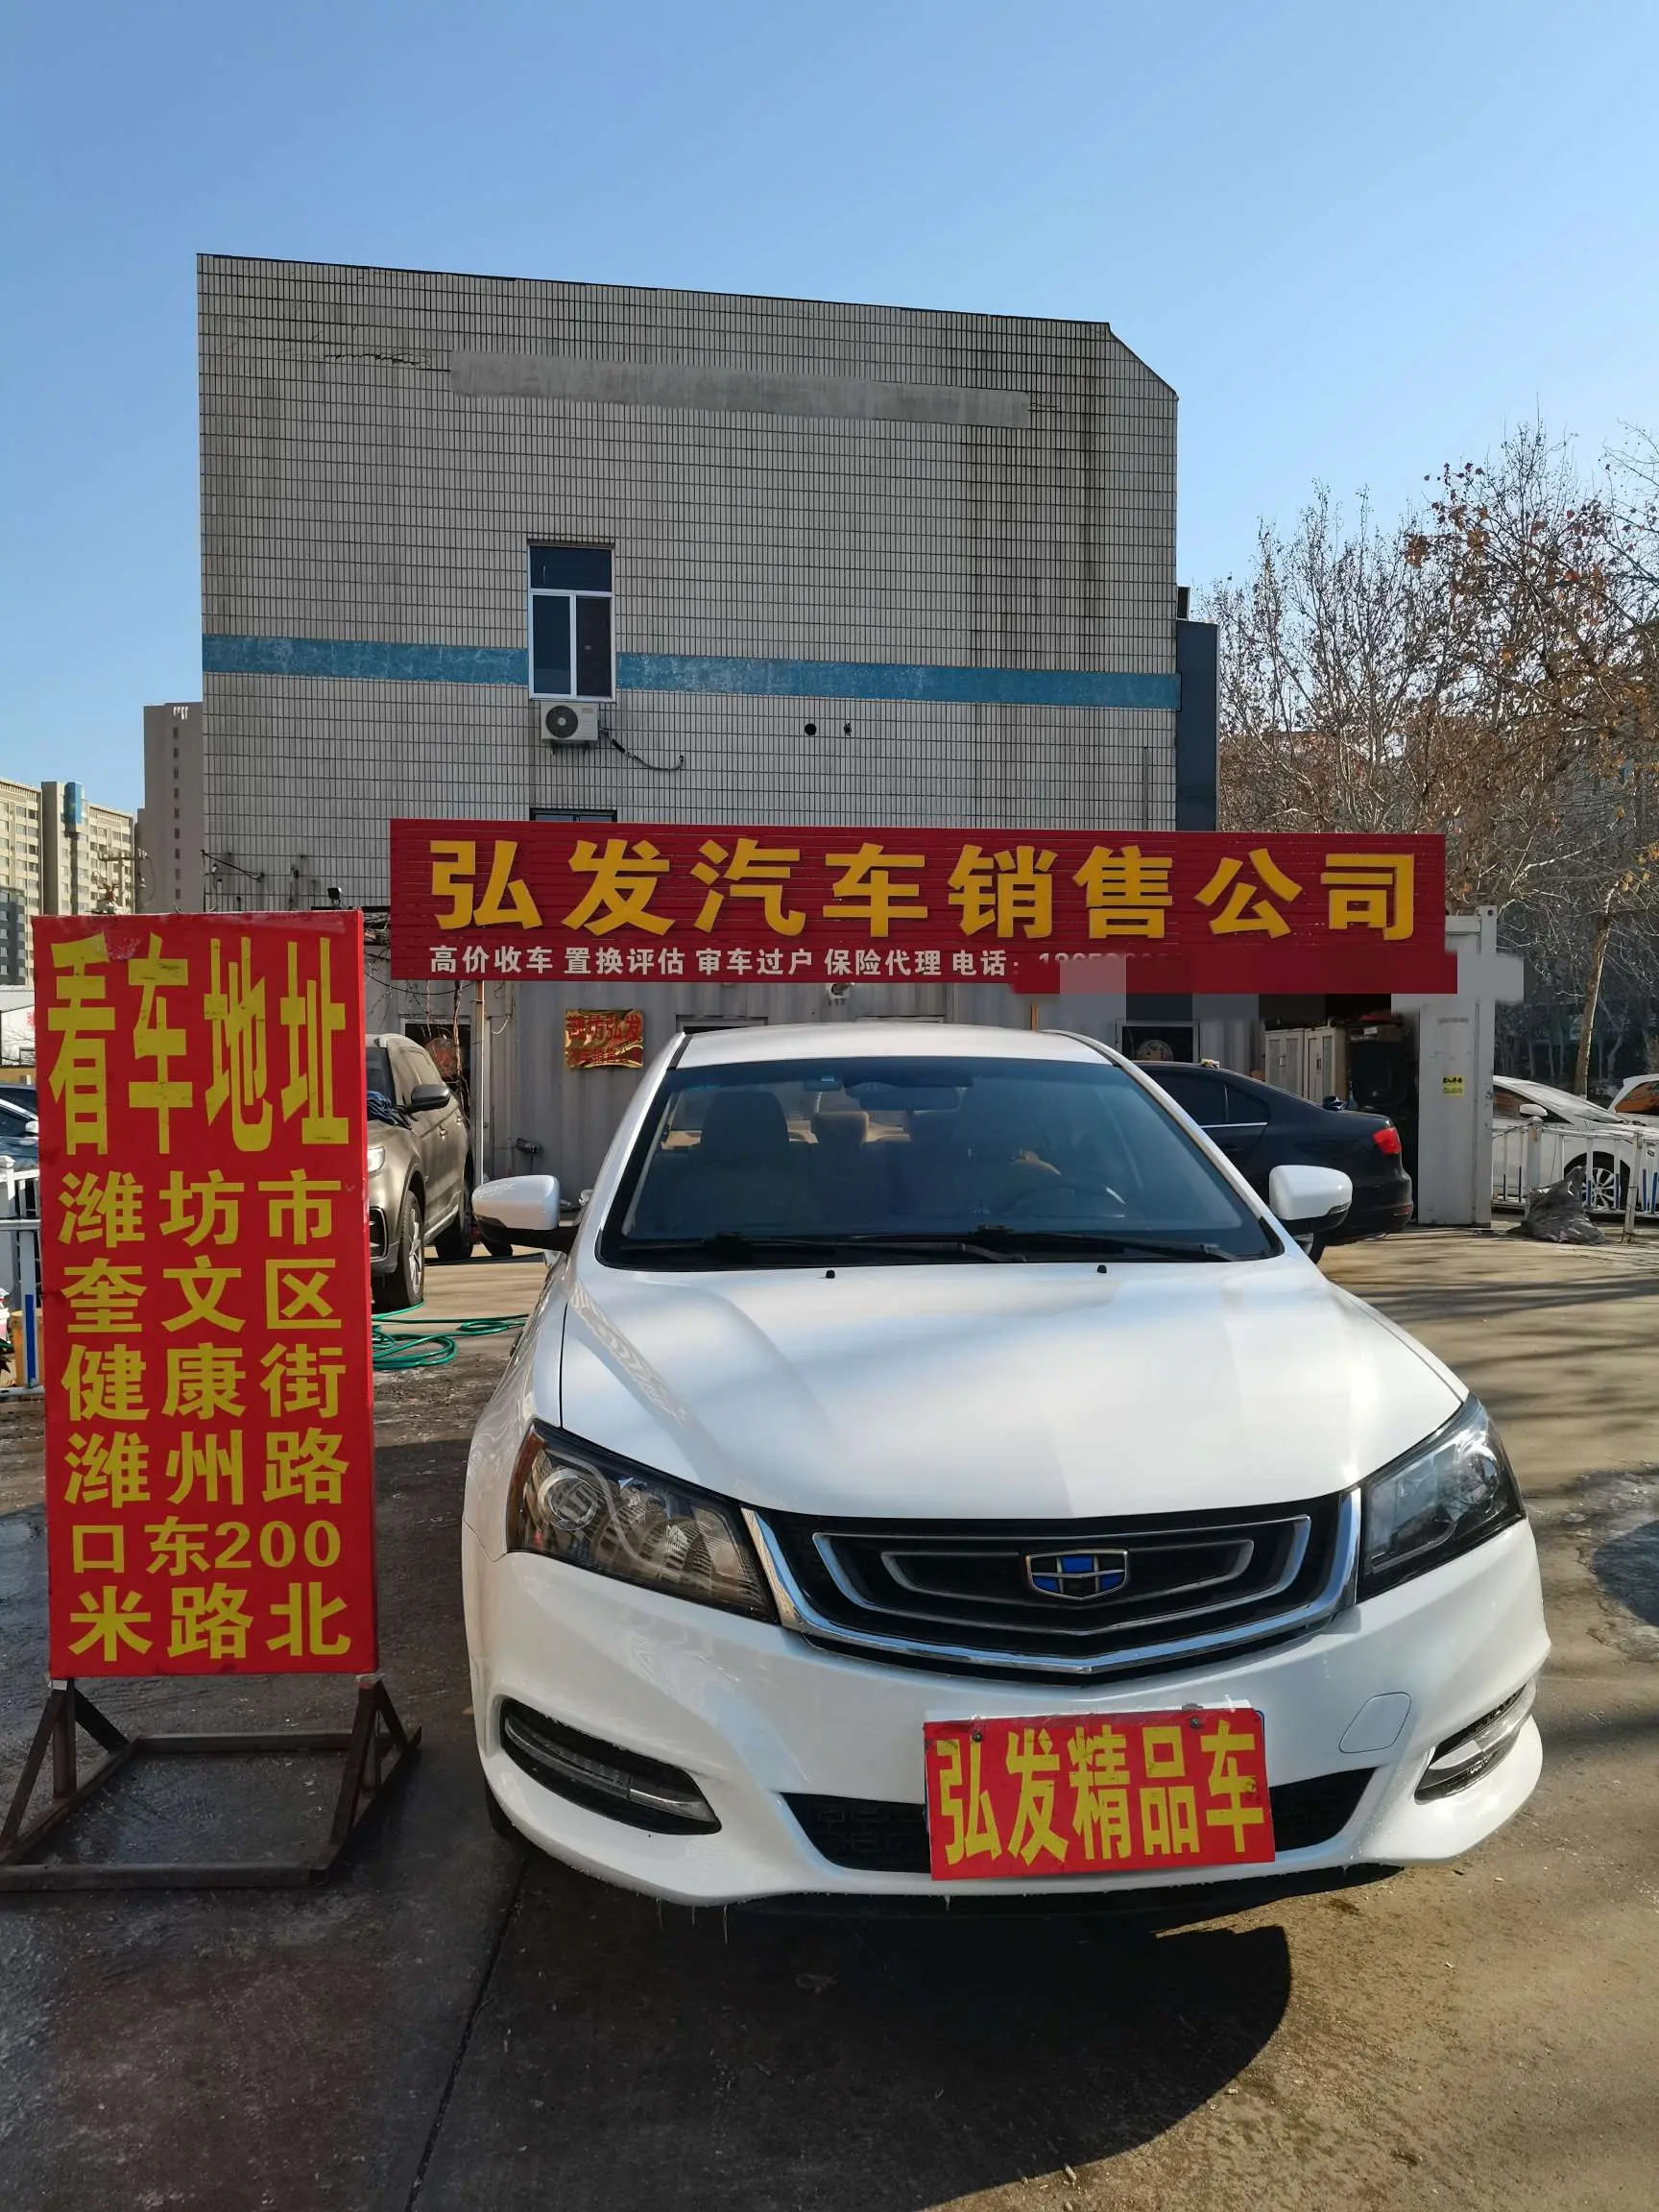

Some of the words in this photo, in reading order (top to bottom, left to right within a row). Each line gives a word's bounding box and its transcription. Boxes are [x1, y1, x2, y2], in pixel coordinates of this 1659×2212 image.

[429, 838, 1415, 941] 弘发汽车销售公司
[429, 945, 553, 974] 高价收车
[564, 947, 685, 975] 置换评估
[695, 948, 813, 975] 审车过户
[824, 948, 942, 976] 保险代理
[47, 932, 349, 1155] 看车地址
[59, 1168, 342, 1247] 潍坊市
[61, 1255, 342, 1334] 奎文区
[61, 1343, 347, 1421] 健康街
[64, 1427, 349, 1508] 潍州路
[71, 1516, 341, 1577] 口东200
[69, 1580, 351, 1661] 米路北
[936, 1720, 1263, 1865] 弘发精品车
